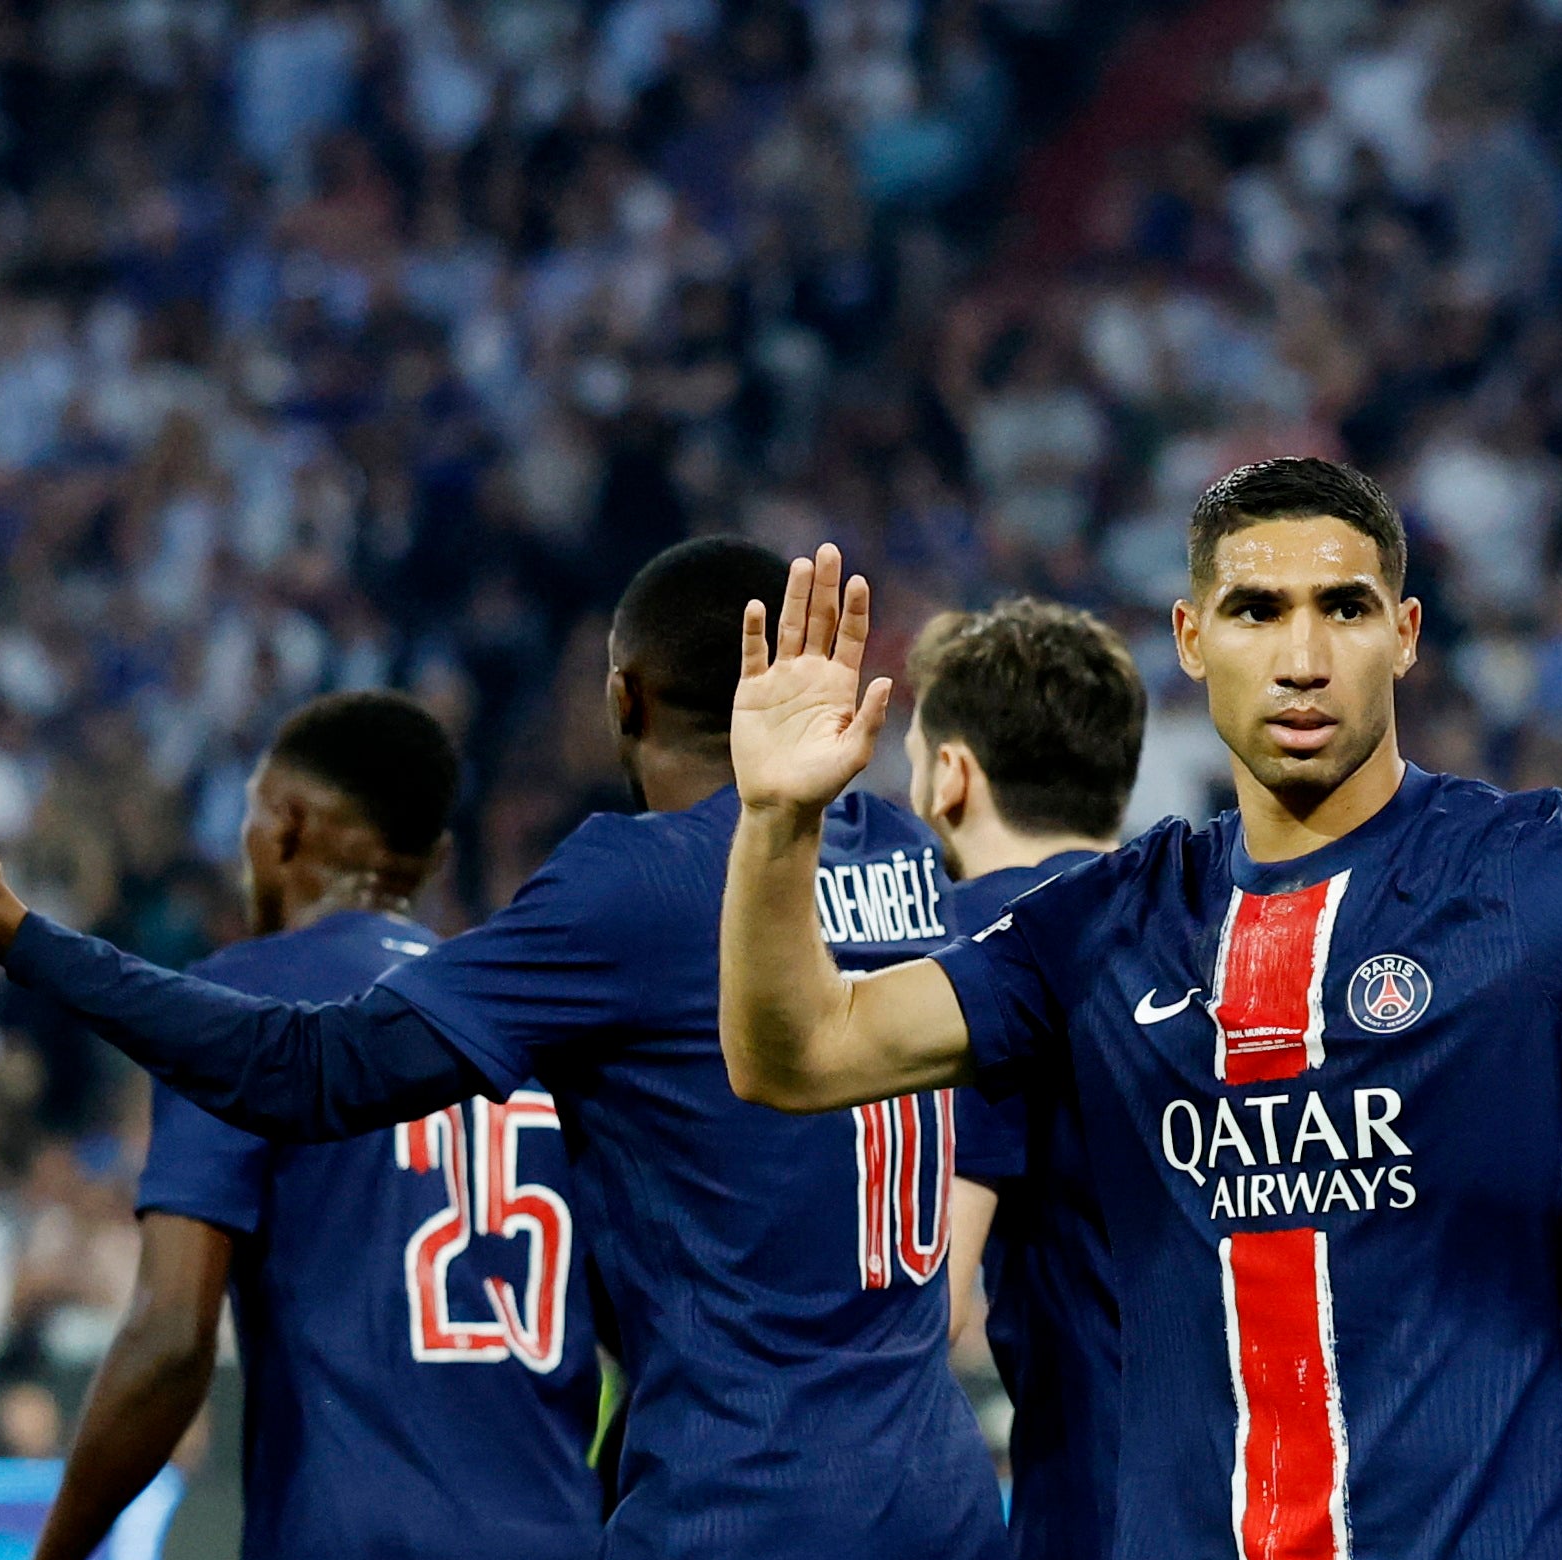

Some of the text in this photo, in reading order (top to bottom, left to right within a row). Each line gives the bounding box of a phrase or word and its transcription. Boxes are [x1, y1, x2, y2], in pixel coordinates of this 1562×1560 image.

[1359, 958, 1416, 981] PARIS
[1162, 1087, 1413, 1187] QATAR
[394, 1089, 573, 1375] 25
[851, 1087, 956, 1291] 10
[1210, 1165, 1417, 1220] AIRWAYS
